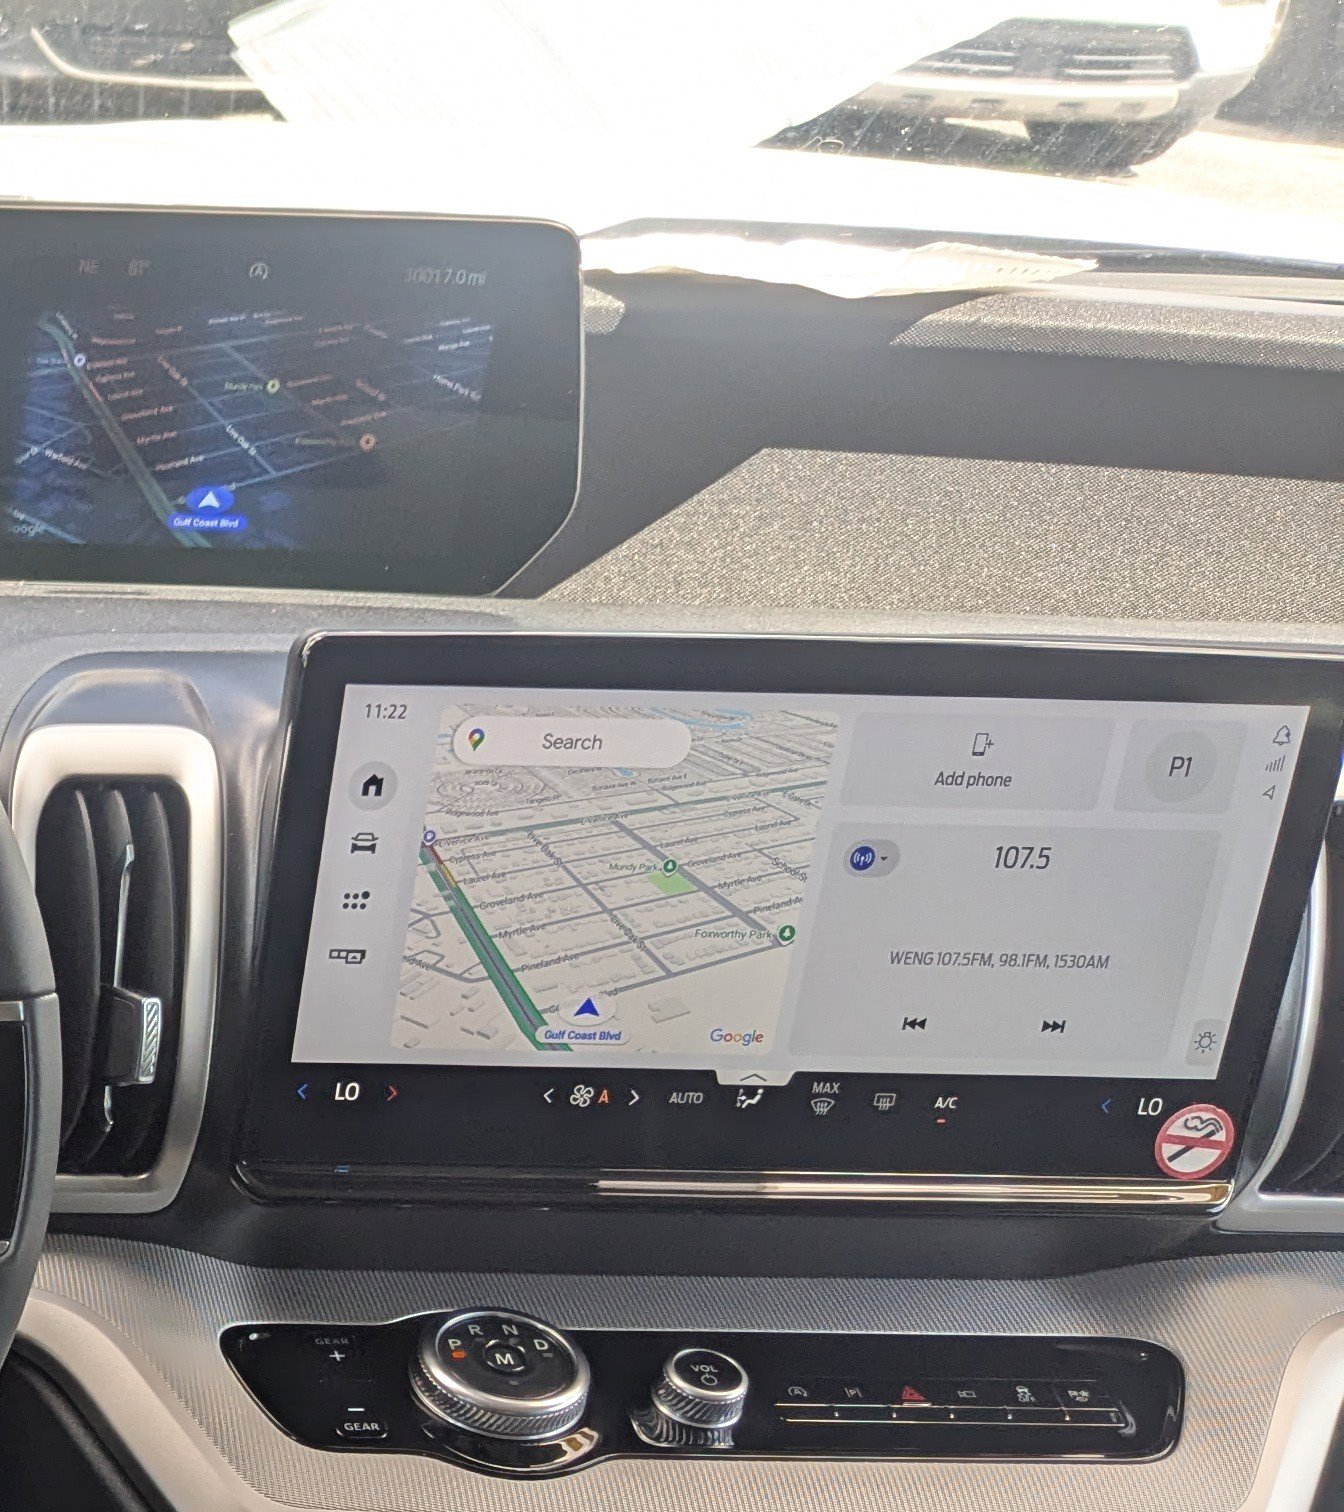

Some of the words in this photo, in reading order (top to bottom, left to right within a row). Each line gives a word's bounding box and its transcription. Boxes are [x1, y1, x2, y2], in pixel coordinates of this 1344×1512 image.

[173, 517, 192, 528] Gulf
[193, 518, 219, 528] Coast
[220, 518, 240, 529] Blvd
[364, 702, 407, 720] 11:22
[542, 733, 603, 750] Search
[1168, 756, 1193, 778] P1
[934, 771, 963, 787] Add
[965, 771, 1012, 790] phone
[660, 838, 685, 848] Laurel
[449, 852, 481, 865] Cypress
[481, 850, 497, 858] Ave
[541, 843, 557, 860] Oak
[687, 853, 727, 867] Groveland
[727, 851, 743, 860] Ave
[994, 845, 1052, 870] 107.5
[608, 862, 637, 873] Mundy
[639, 862, 658, 872] Park
[771, 857, 799, 876] School
[463, 874, 491, 885] Laurel
[491, 871, 507, 880] Ave
[717, 877, 747, 890] Myrtle
[747, 874, 764, 883] Ave
[479, 893, 526, 910] Groveland
[526, 891, 544, 900] Ave
[753, 897, 793, 914] Pineland
[498, 927, 527, 939] Myrtle
[528, 924, 547, 933] Ave
[694, 929, 748, 940] Foxworthy
[749, 930, 772, 939] Park
[521, 956, 562, 973] Pineland
[562, 953, 580, 963] Ave
[889, 951, 935, 966] WENG
[936, 951, 995, 969] 107.5FM,
[998, 952, 1051, 970] 98.1FM,
[1054, 953, 1110, 970] 1530AM
[544, 1029, 567, 1040] Gulf
[568, 1030, 597, 1041] Coast
[598, 1030, 623, 1041] Blvd
[710, 1028, 764, 1046] Google
[334, 1082, 360, 1101] LO
[812, 1082, 841, 1095] MAX
[598, 1089, 610, 1104] A
[669, 1092, 704, 1104] AUTO
[934, 1096, 958, 1109] A/C
[1137, 1097, 1163, 1116] LO
[468, 1324, 483, 1336] R
[502, 1324, 518, 1336] N
[448, 1338, 462, 1350] P
[533, 1339, 549, 1350] D
[495, 1353, 514, 1365] M
[690, 1364, 719, 1373] VOL
[344, 1422, 380, 1431] GEAR
